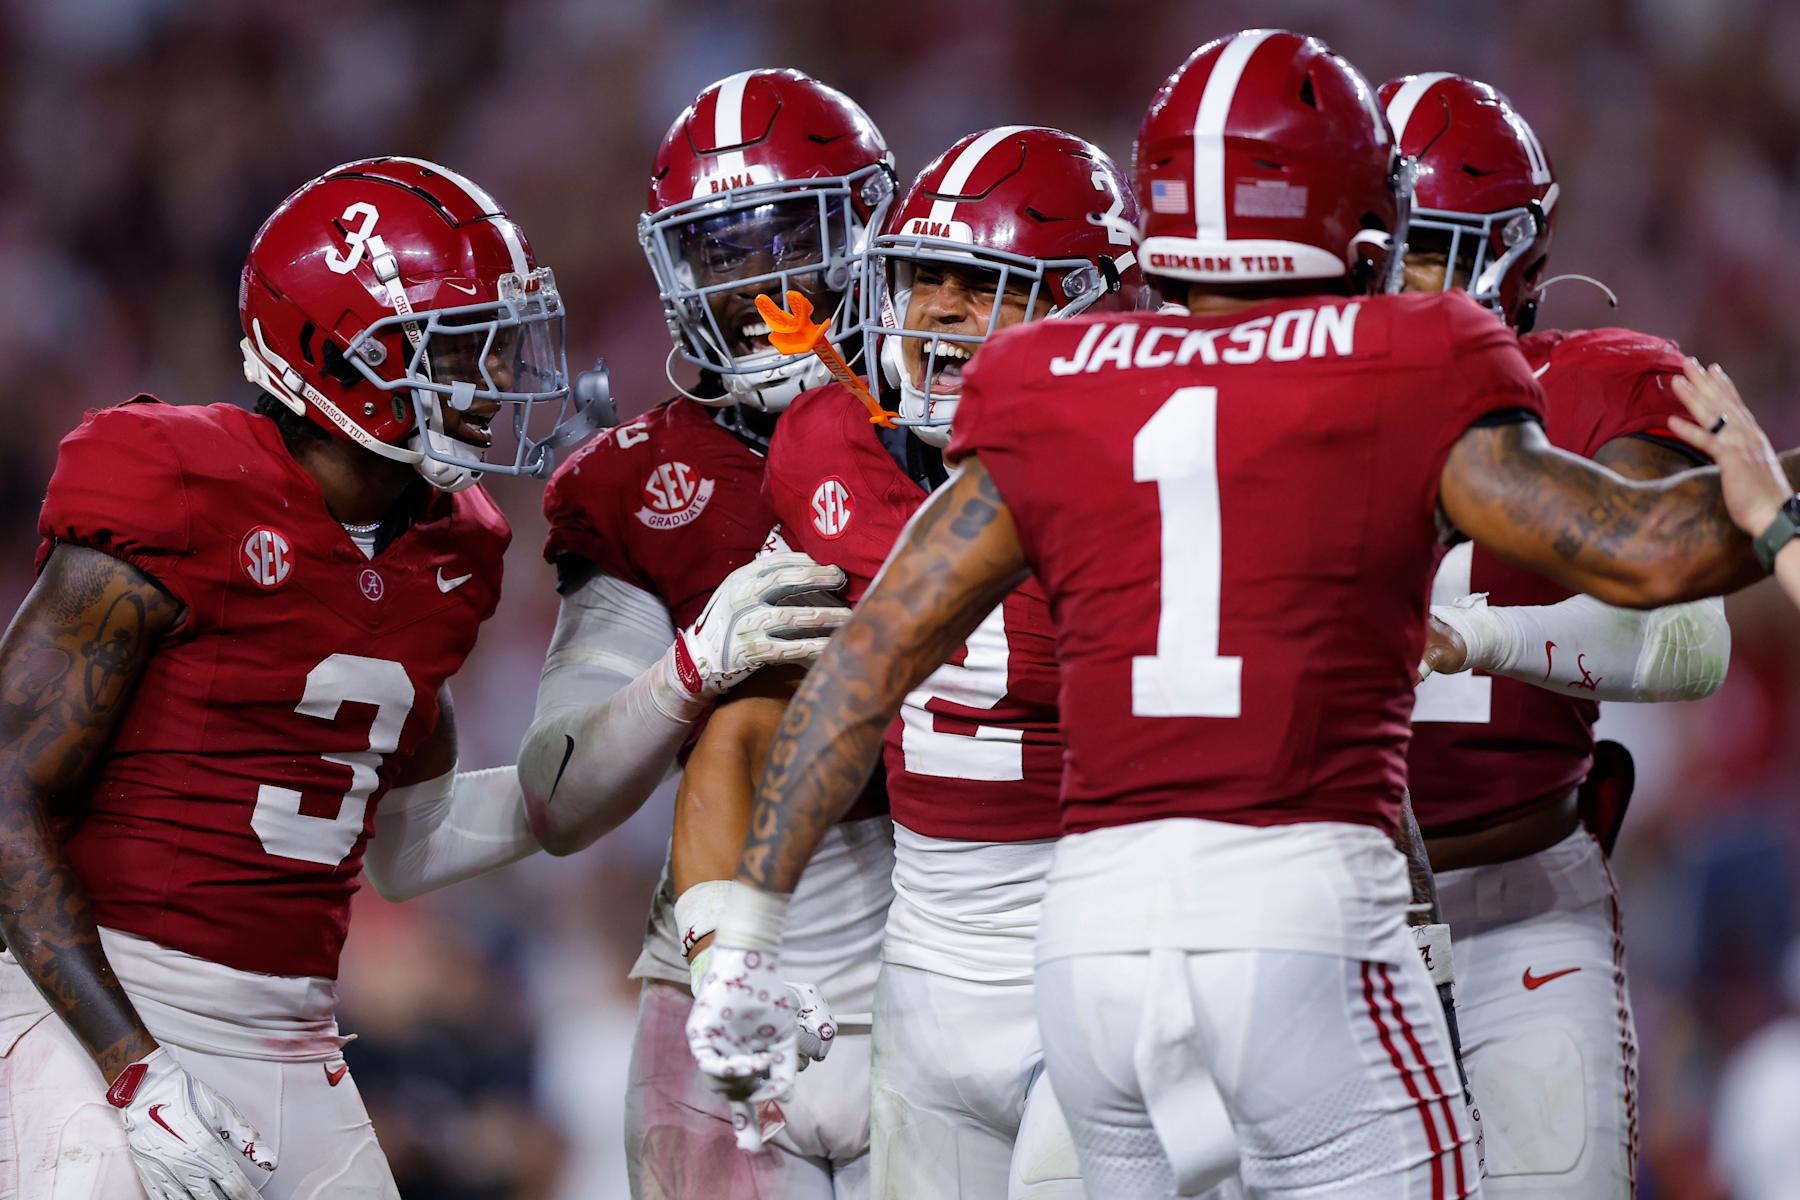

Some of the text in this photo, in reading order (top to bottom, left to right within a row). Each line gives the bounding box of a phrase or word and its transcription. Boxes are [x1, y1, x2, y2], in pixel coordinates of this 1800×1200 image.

[710, 173, 754, 193] BAMA
[1091, 171, 1131, 246] 2
[324, 201, 379, 275] 3
[912, 221, 950, 238] BAMA
[1150, 253, 1295, 273] CRIMSON TIDE
[395, 295, 421, 344] CRISON
[1050, 303, 1361, 376] JACKSON
[306, 390, 372, 446] CRIMSON TIDE
[645, 461, 695, 510] SEC
[648, 494, 707, 528] GRADUATE
[811, 480, 851, 535] SEC
[244, 530, 291, 586] SEC
[1131, 386, 1243, 717] 1
[900, 602, 1025, 781] 2
[250, 653, 416, 866] 3
